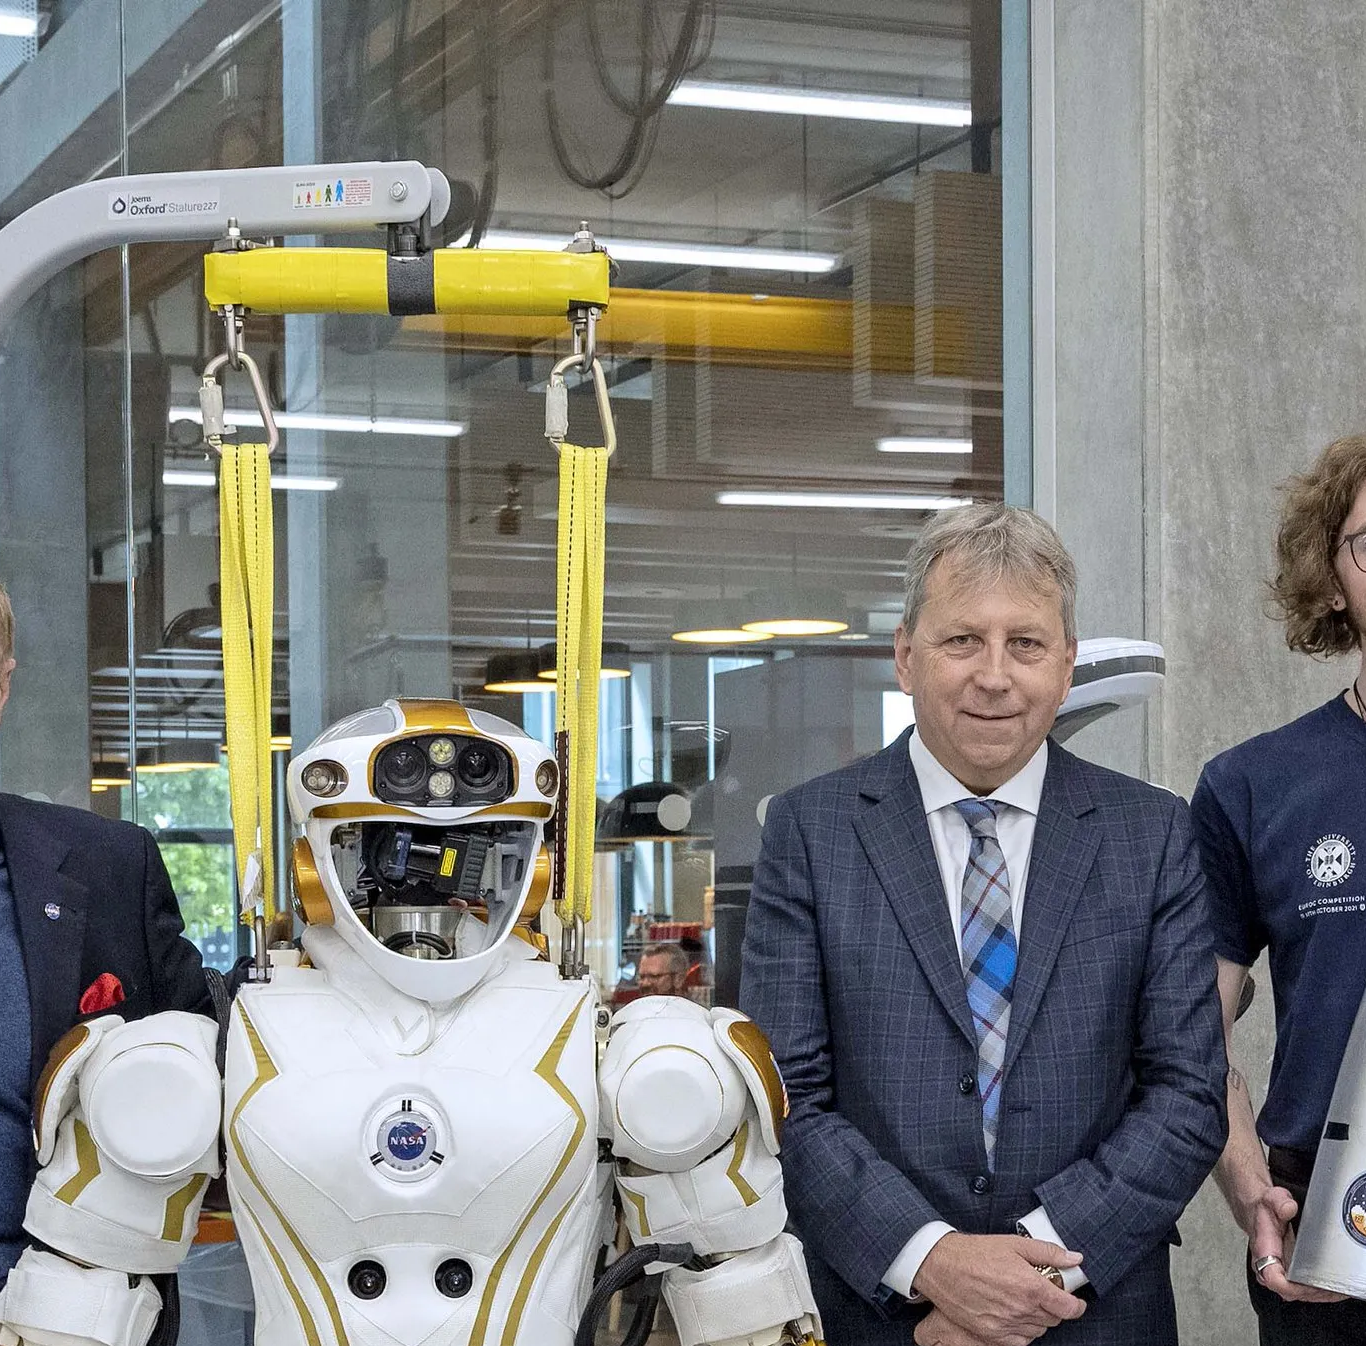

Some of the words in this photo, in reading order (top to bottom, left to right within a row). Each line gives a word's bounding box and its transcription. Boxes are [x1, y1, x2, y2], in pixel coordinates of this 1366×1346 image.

[1316, 833, 1357, 856] UNIVERSITY
[1305, 845, 1316, 862] THE
[1313, 862, 1356, 888] EDINBURGH
[1317, 895, 1365, 905] COMPETITION
[1316, 906, 1344, 915] OCTOBER
[390, 1136, 424, 1146] NASA
